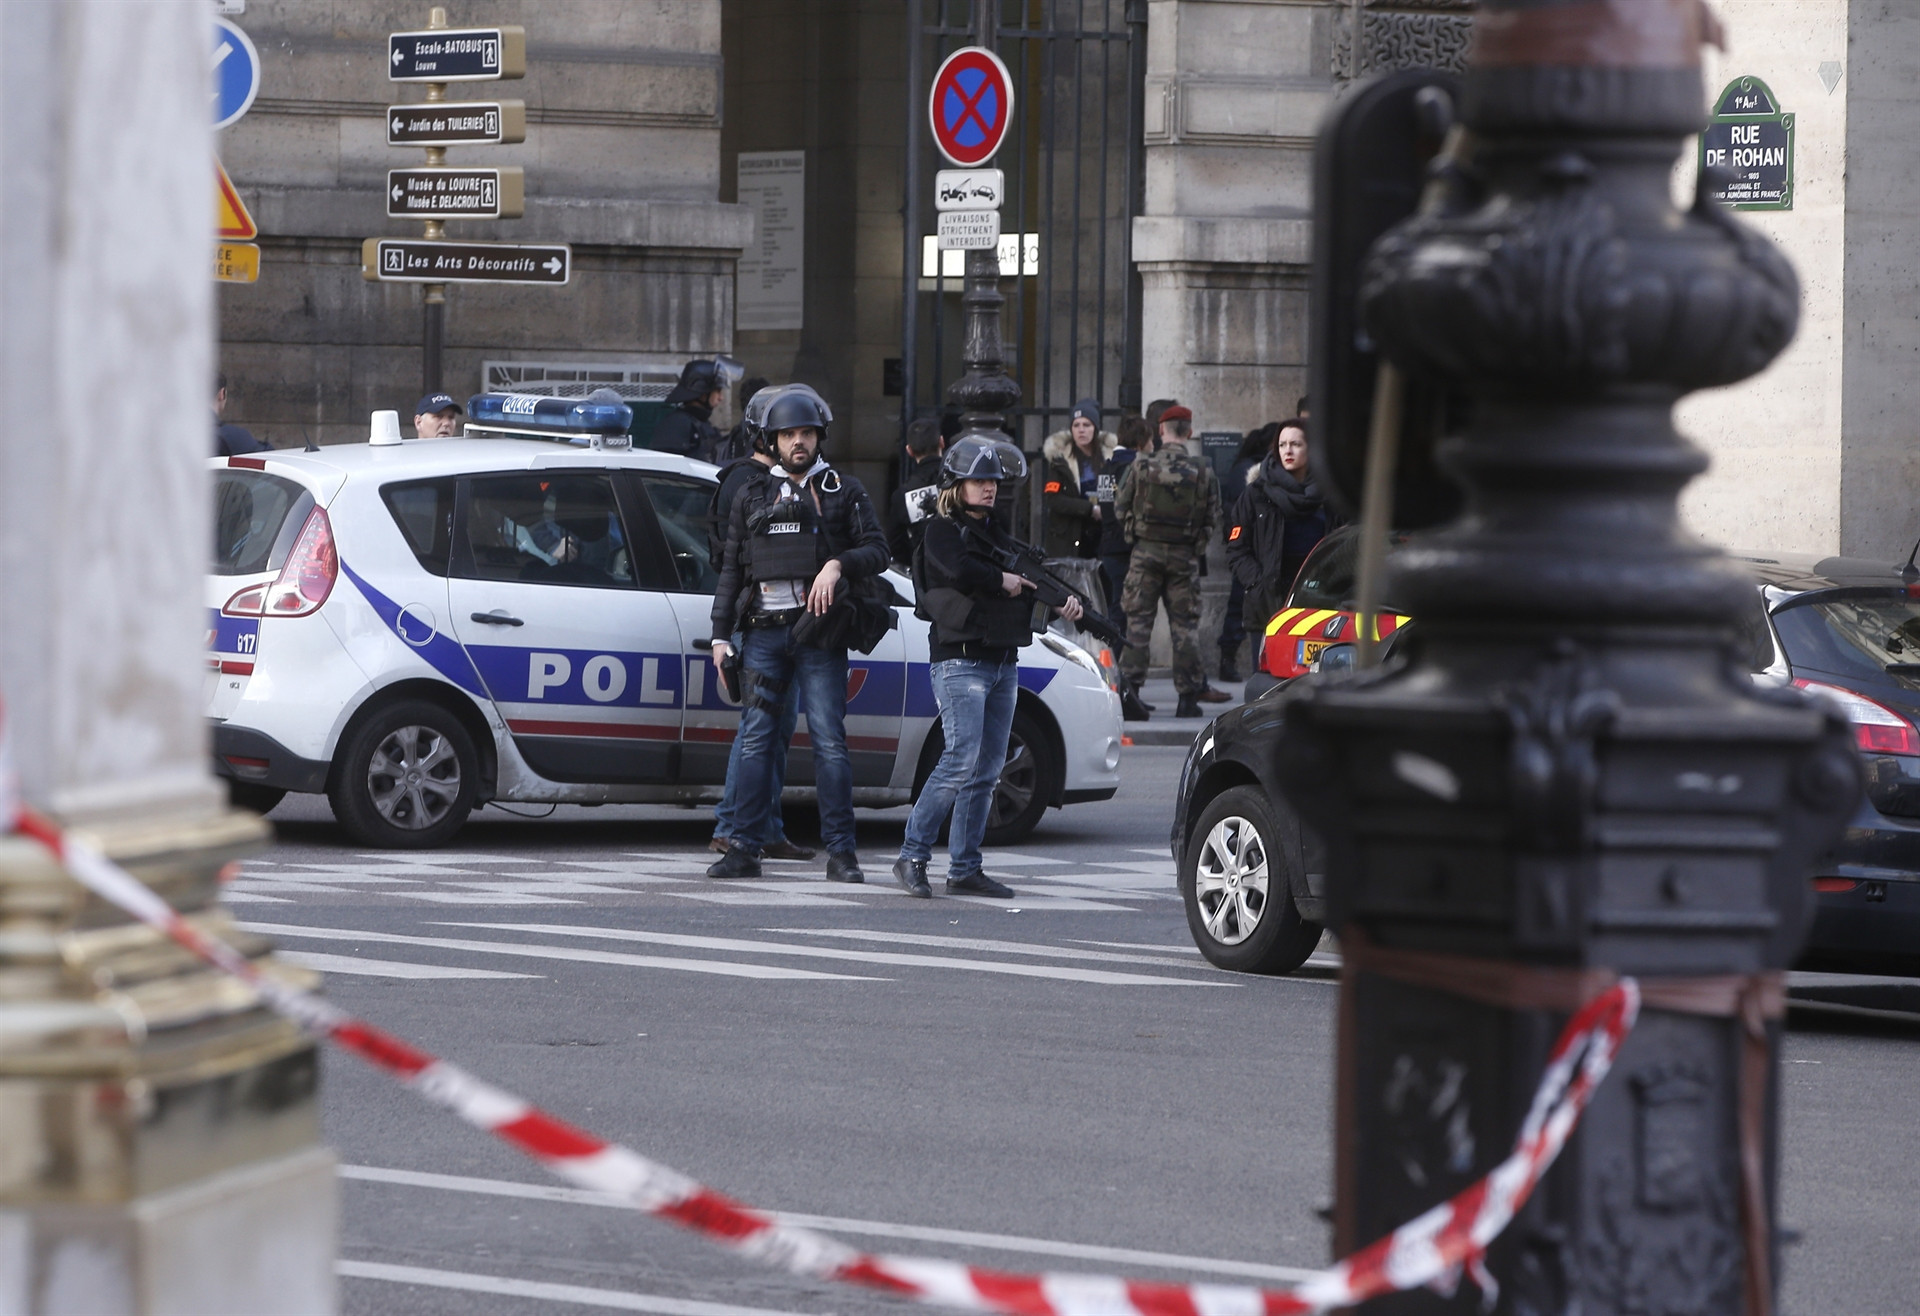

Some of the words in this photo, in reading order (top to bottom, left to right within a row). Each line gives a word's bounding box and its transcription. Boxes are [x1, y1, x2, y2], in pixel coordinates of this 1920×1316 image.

[415, 39, 482, 55] Escale-BATOBUS
[415, 60, 437, 71] Louvre
[408, 118, 431, 132] Jardin
[432, 117, 446, 131] des
[448, 116, 484, 131] TUILERIES
[1731, 125, 1760, 145] RUE
[1706, 149, 1726, 168] DE
[1732, 147, 1785, 167] ROHAN
[407, 178, 433, 191] Musée
[436, 178, 446, 191] du
[449, 177, 480, 191] LOUVRE
[1728, 182, 1753, 190] CARDINAL
[1753, 182, 1761, 190] ET
[1752, 191, 1760, 199] DE
[1760, 190, 1781, 199] FRANCE
[407, 195, 431, 208] Musée
[439, 195, 480, 208] DELACROIX
[945, 214, 990, 224] LIVRAISONS
[941, 226, 993, 235] STRICTEMENT
[947, 237, 992, 247] INTERDITES
[407, 254, 429, 268] Les
[435, 255, 462, 269] Arts
[468, 256, 536, 271] Décoratifs
[504, 397, 535, 413] POLICE
[769, 524, 799, 532] POLICE
